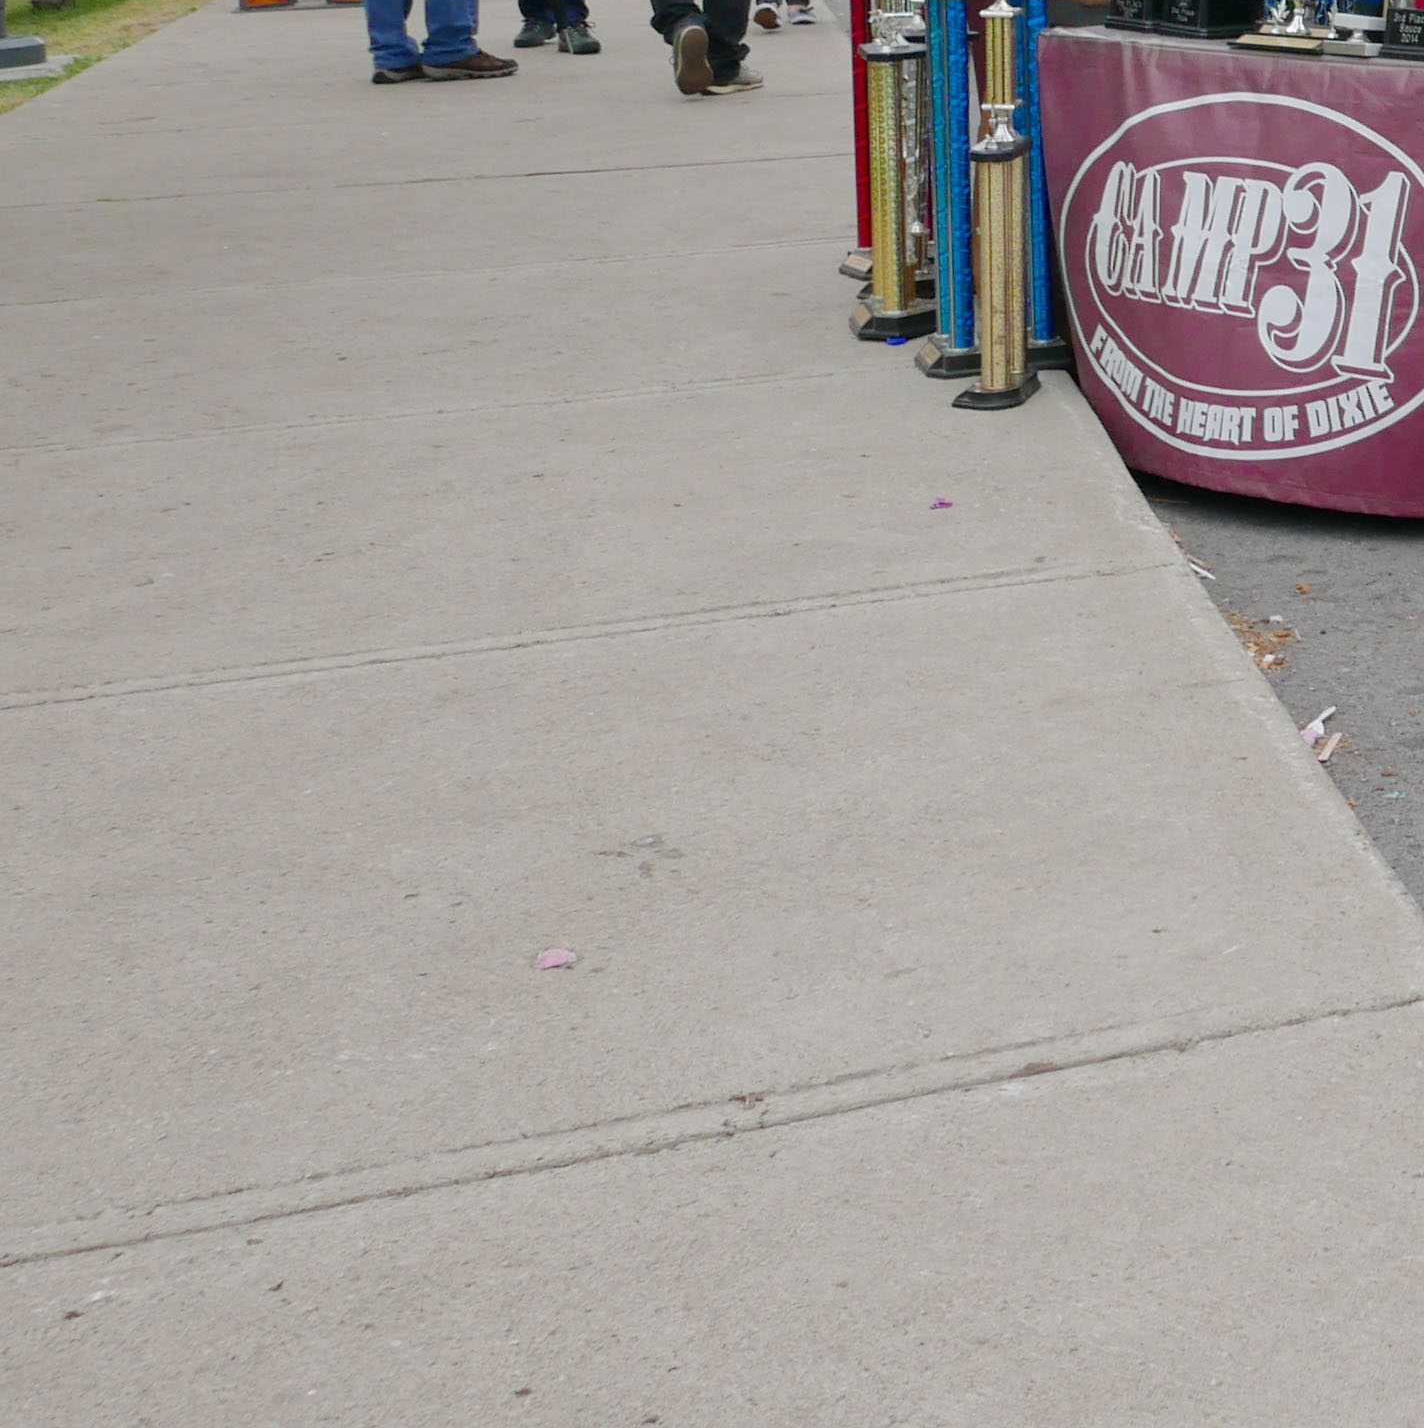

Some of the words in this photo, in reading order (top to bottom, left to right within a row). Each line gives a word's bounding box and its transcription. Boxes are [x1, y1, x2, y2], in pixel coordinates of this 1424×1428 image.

[1399, 24, 1422, 33] Sauce
[1401, 34, 1419, 44] 2014
[1094, 160, 1288, 318] CAMP
[1257, 162, 1410, 383] 31
[1089, 324, 1143, 405] FROM
[1143, 376, 1176, 426] THE
[1176, 397, 1256, 445] HEART
[1263, 404, 1300, 442] OF
[1306, 380, 1396, 438] DIXIE
